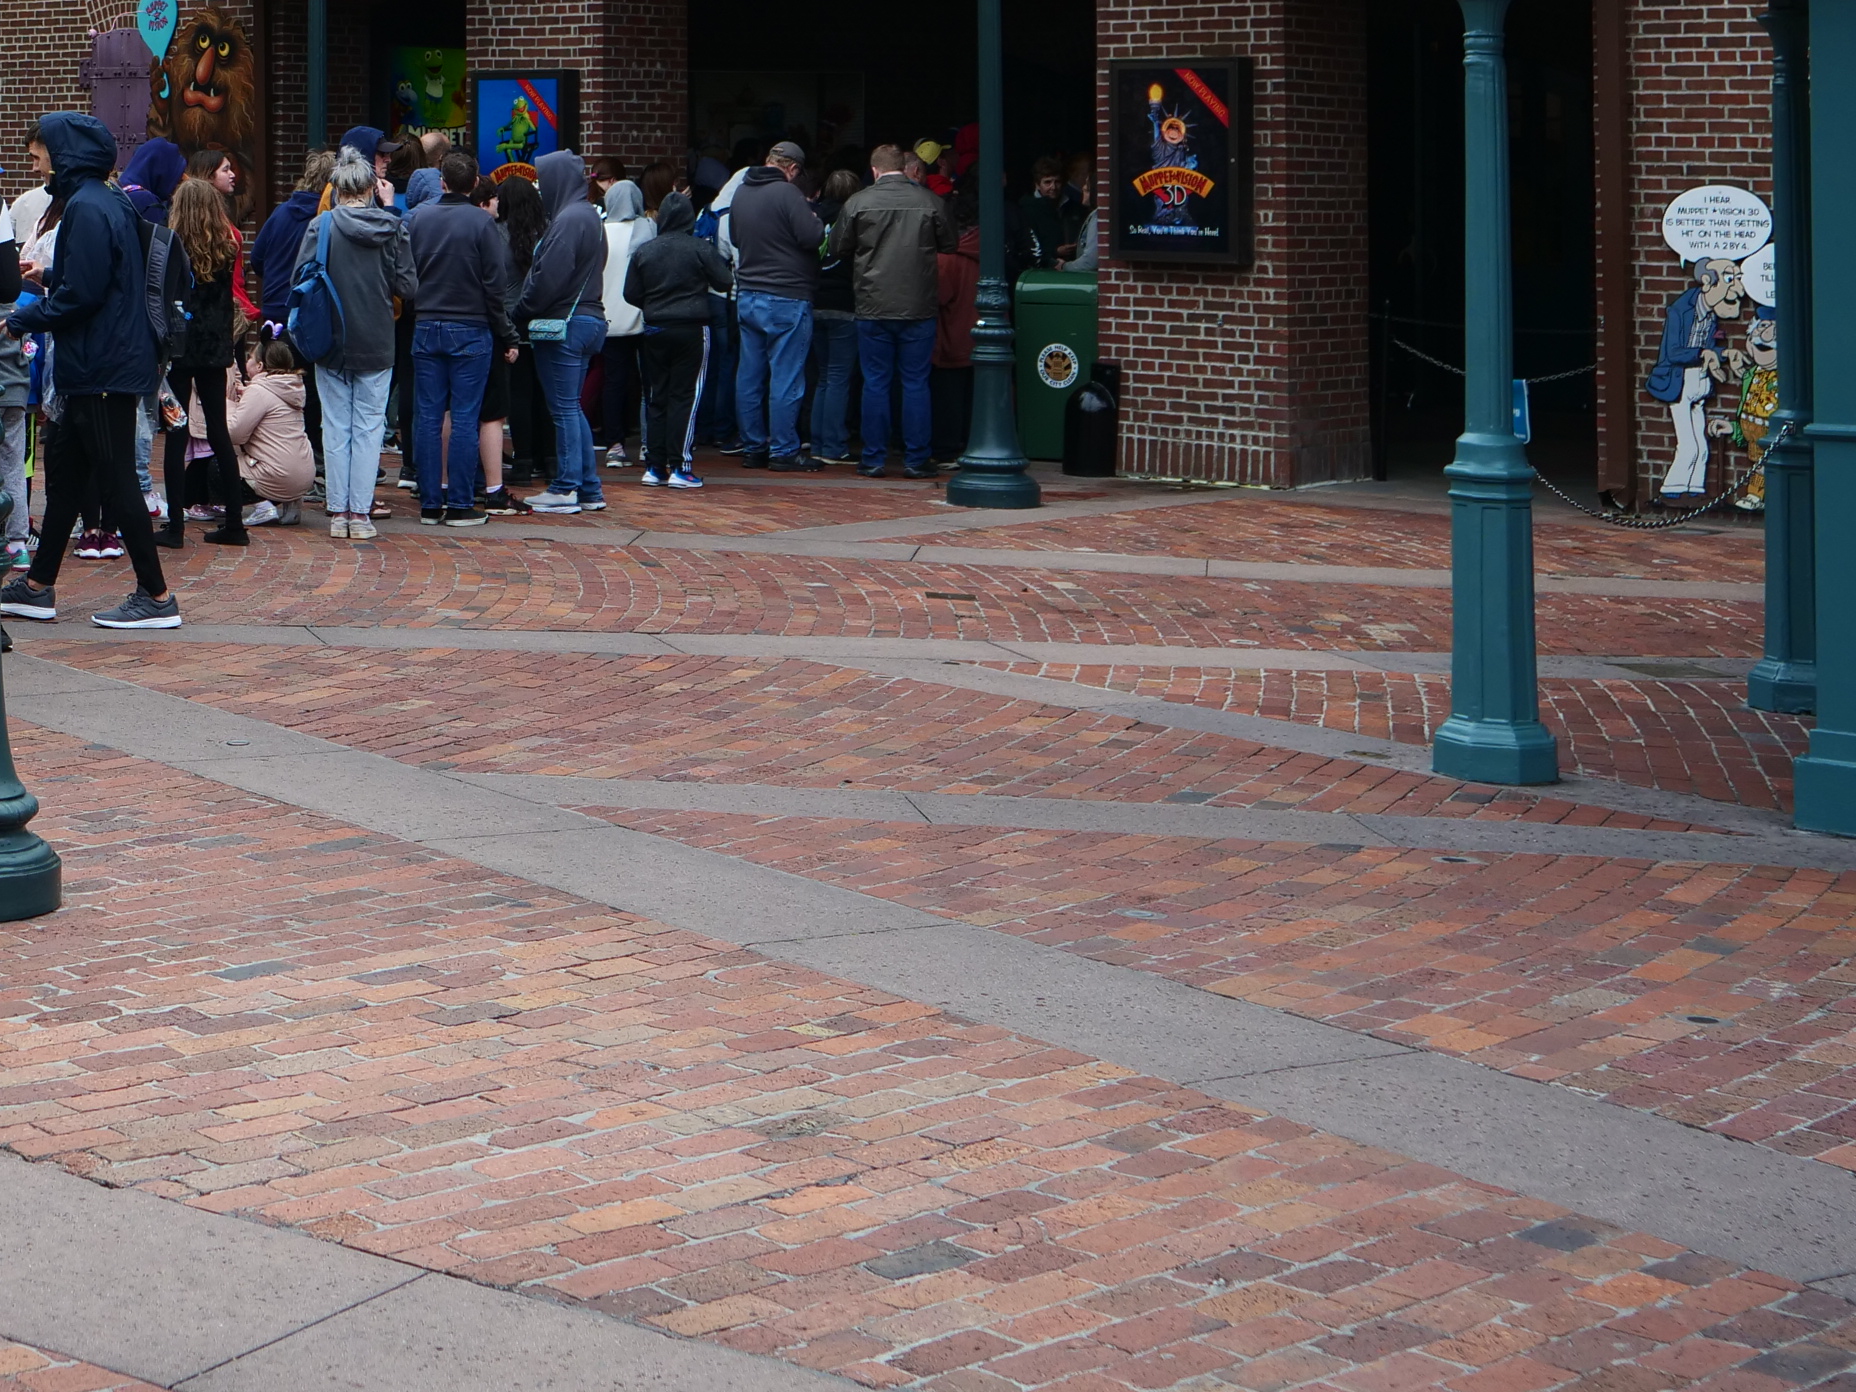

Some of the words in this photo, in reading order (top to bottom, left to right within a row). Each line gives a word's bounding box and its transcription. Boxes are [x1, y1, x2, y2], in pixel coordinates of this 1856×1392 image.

[1163, 184, 1187, 206] 3D
[1709, 196, 1731, 204] HEAR
[1677, 207, 1709, 215] MUPPET
[1665, 218, 1674, 226] IS
[1676, 218, 1706, 226] BETTER
[1708, 219, 1731, 227] THAN
[1734, 219, 1770, 228] GETTING
[1681, 230, 1694, 238] HIT
[1698, 230, 1712, 238] ON
[1714, 230, 1732, 238] THE
[1734, 230, 1757, 238] HEAD
[1689, 241, 1710, 249] WITH
[1713, 241, 1720, 249] A
[1722, 242, 1729, 250] 2
[1729, 242, 1740, 250] BY
